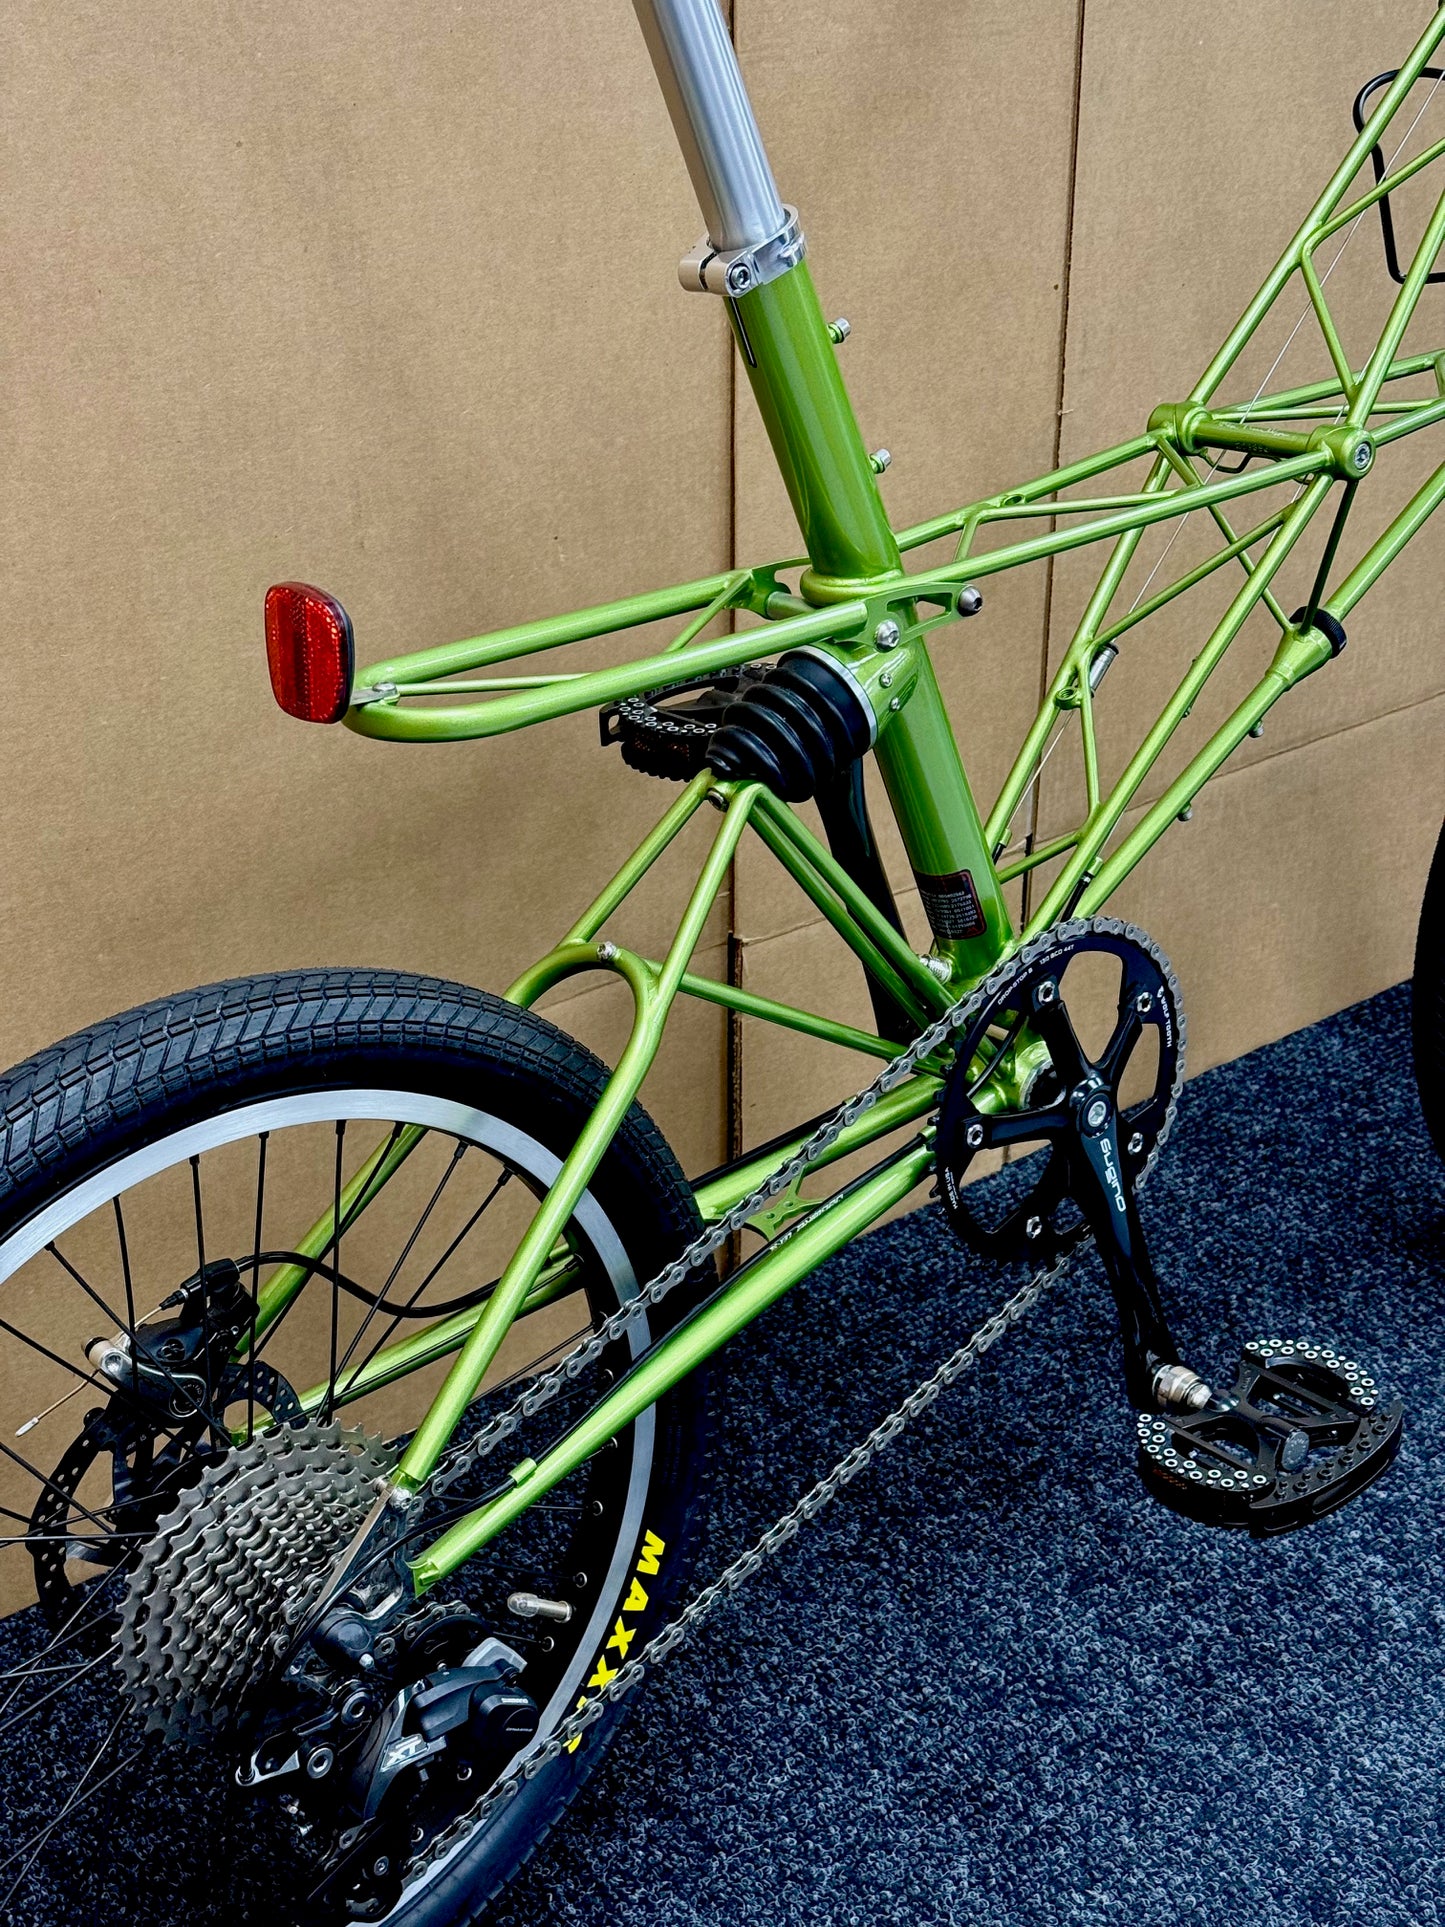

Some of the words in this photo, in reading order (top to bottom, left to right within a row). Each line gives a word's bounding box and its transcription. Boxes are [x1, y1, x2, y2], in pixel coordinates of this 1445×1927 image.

[997, 971, 1028, 1005] DROP-STOP
[1160, 996, 1170, 1019] WOLF
[1165, 1018, 1173, 1048] TOOTH
[388, 1736, 422, 1766] XT
